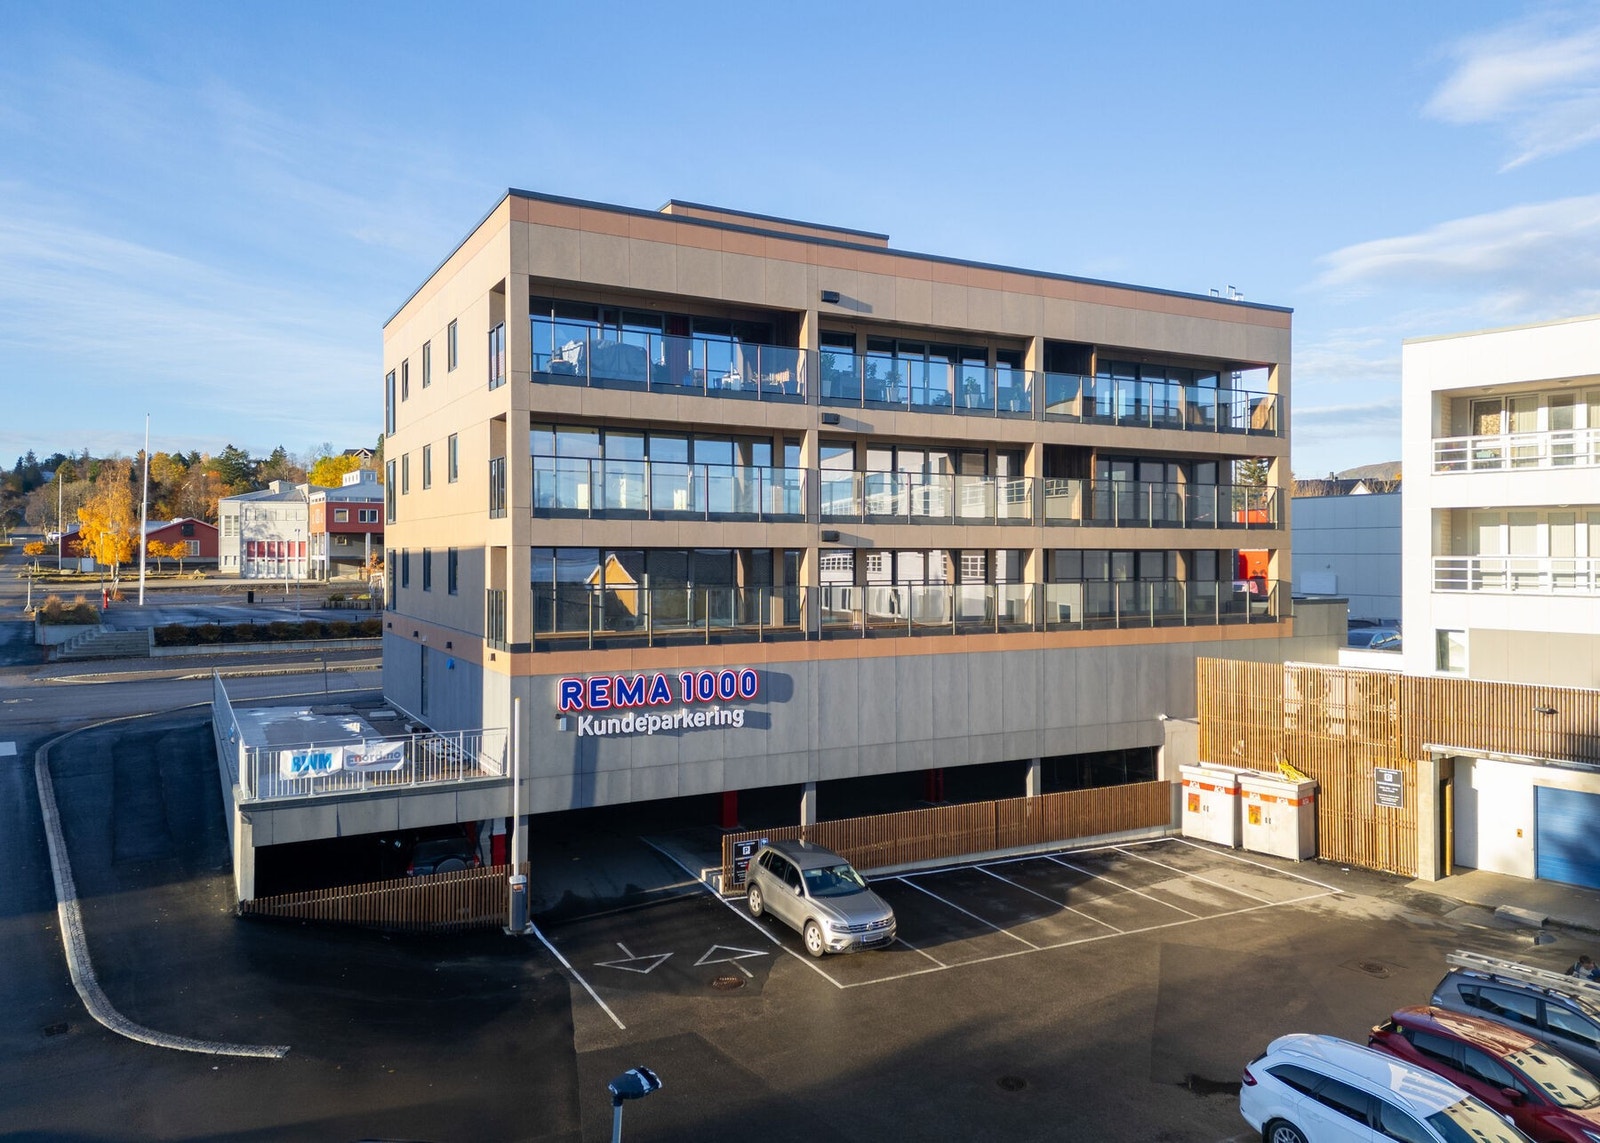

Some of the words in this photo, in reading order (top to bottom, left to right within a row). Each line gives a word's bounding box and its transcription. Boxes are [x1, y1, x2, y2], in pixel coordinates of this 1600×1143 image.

[557, 673, 673, 712] REMA
[679, 668, 759, 703] 1000
[577, 705, 745, 737] Kundeparkering
